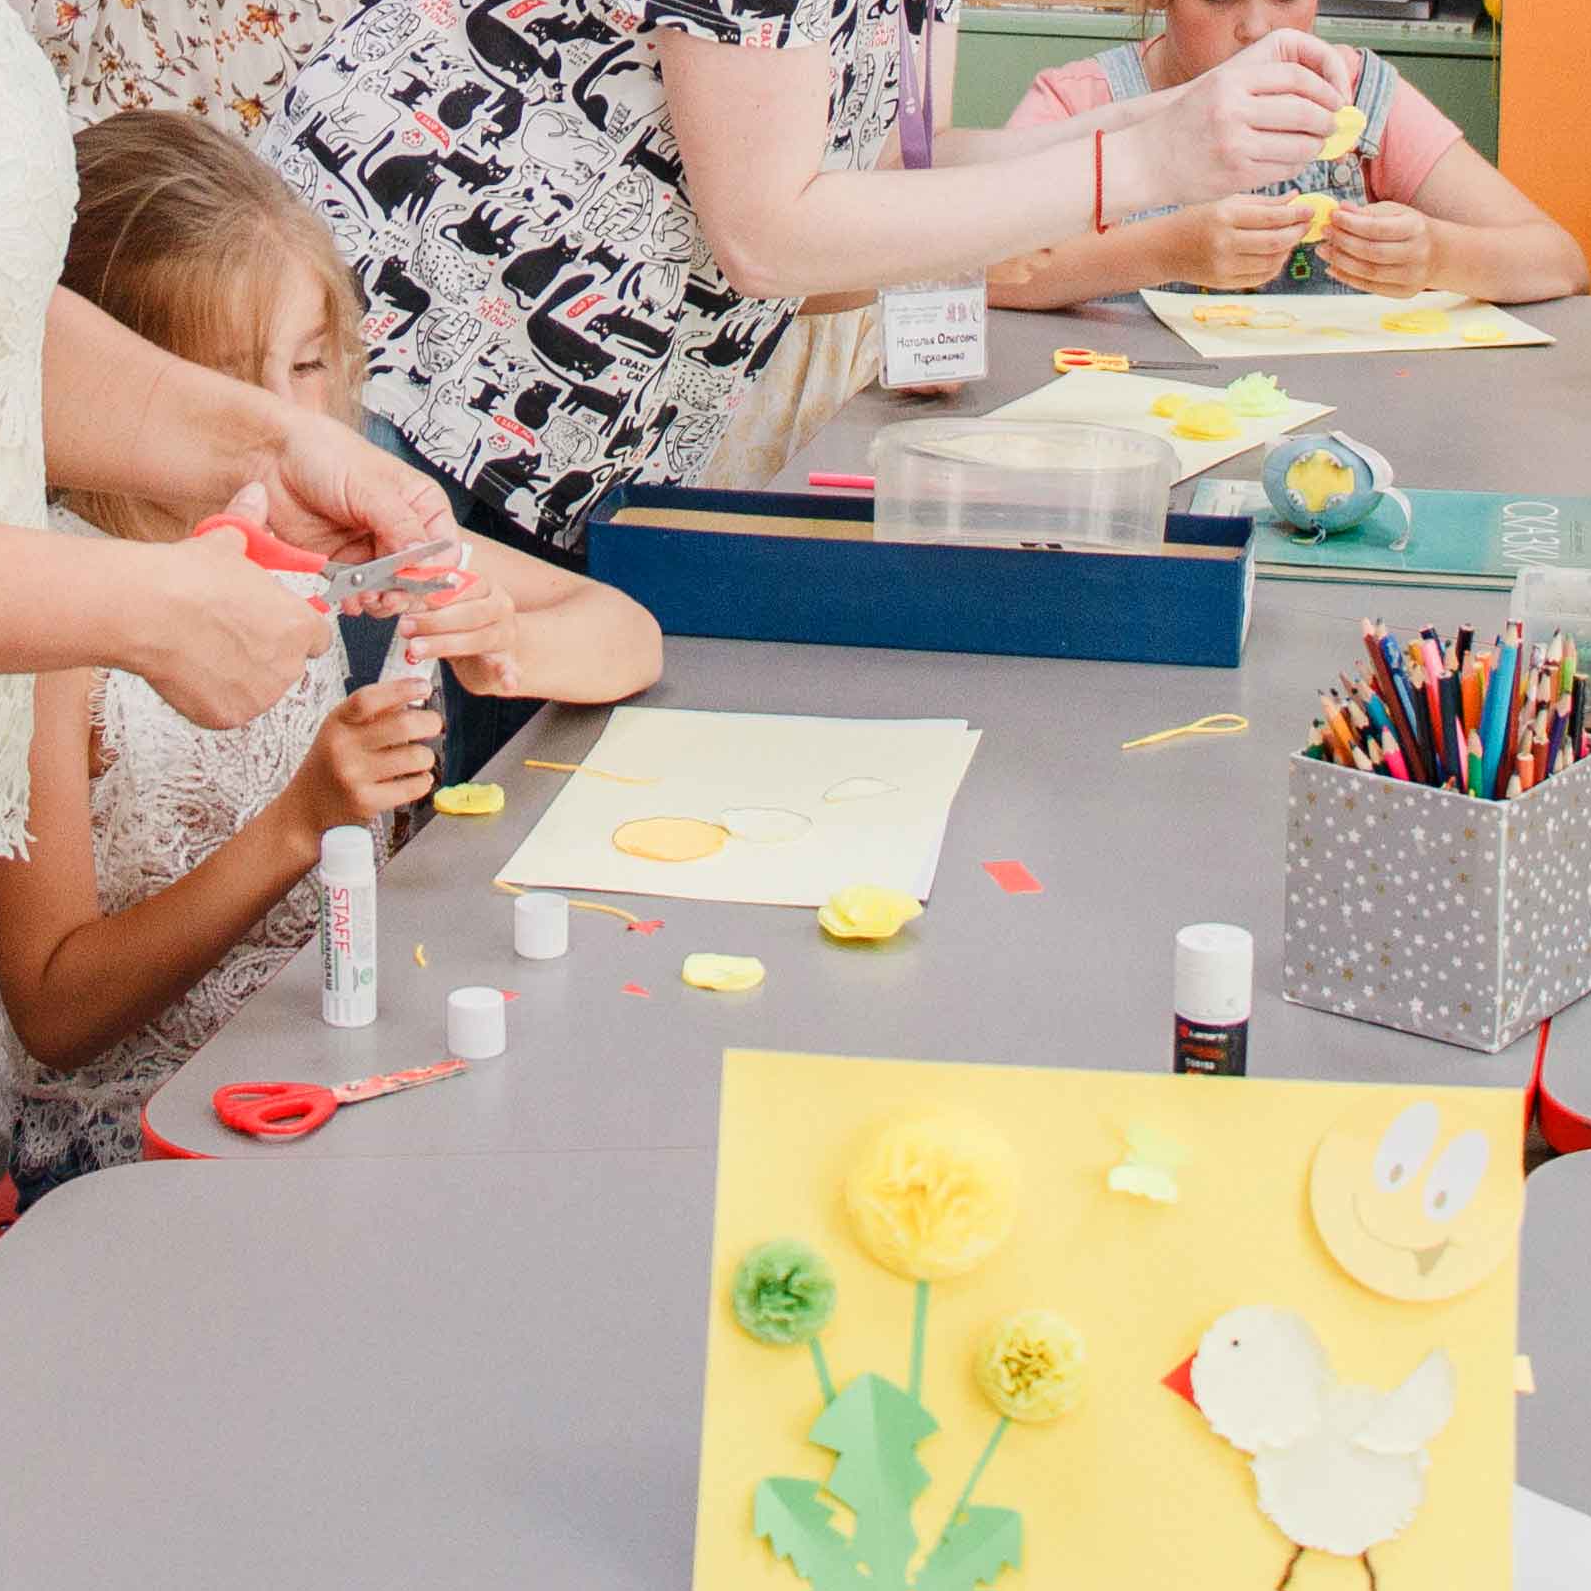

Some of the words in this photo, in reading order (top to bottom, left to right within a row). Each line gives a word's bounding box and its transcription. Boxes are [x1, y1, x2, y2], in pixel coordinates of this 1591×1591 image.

[618, 356, 654, 374] CRAZY
[625, 371, 647, 384] CAT
[332, 887, 351, 955] STAFF
